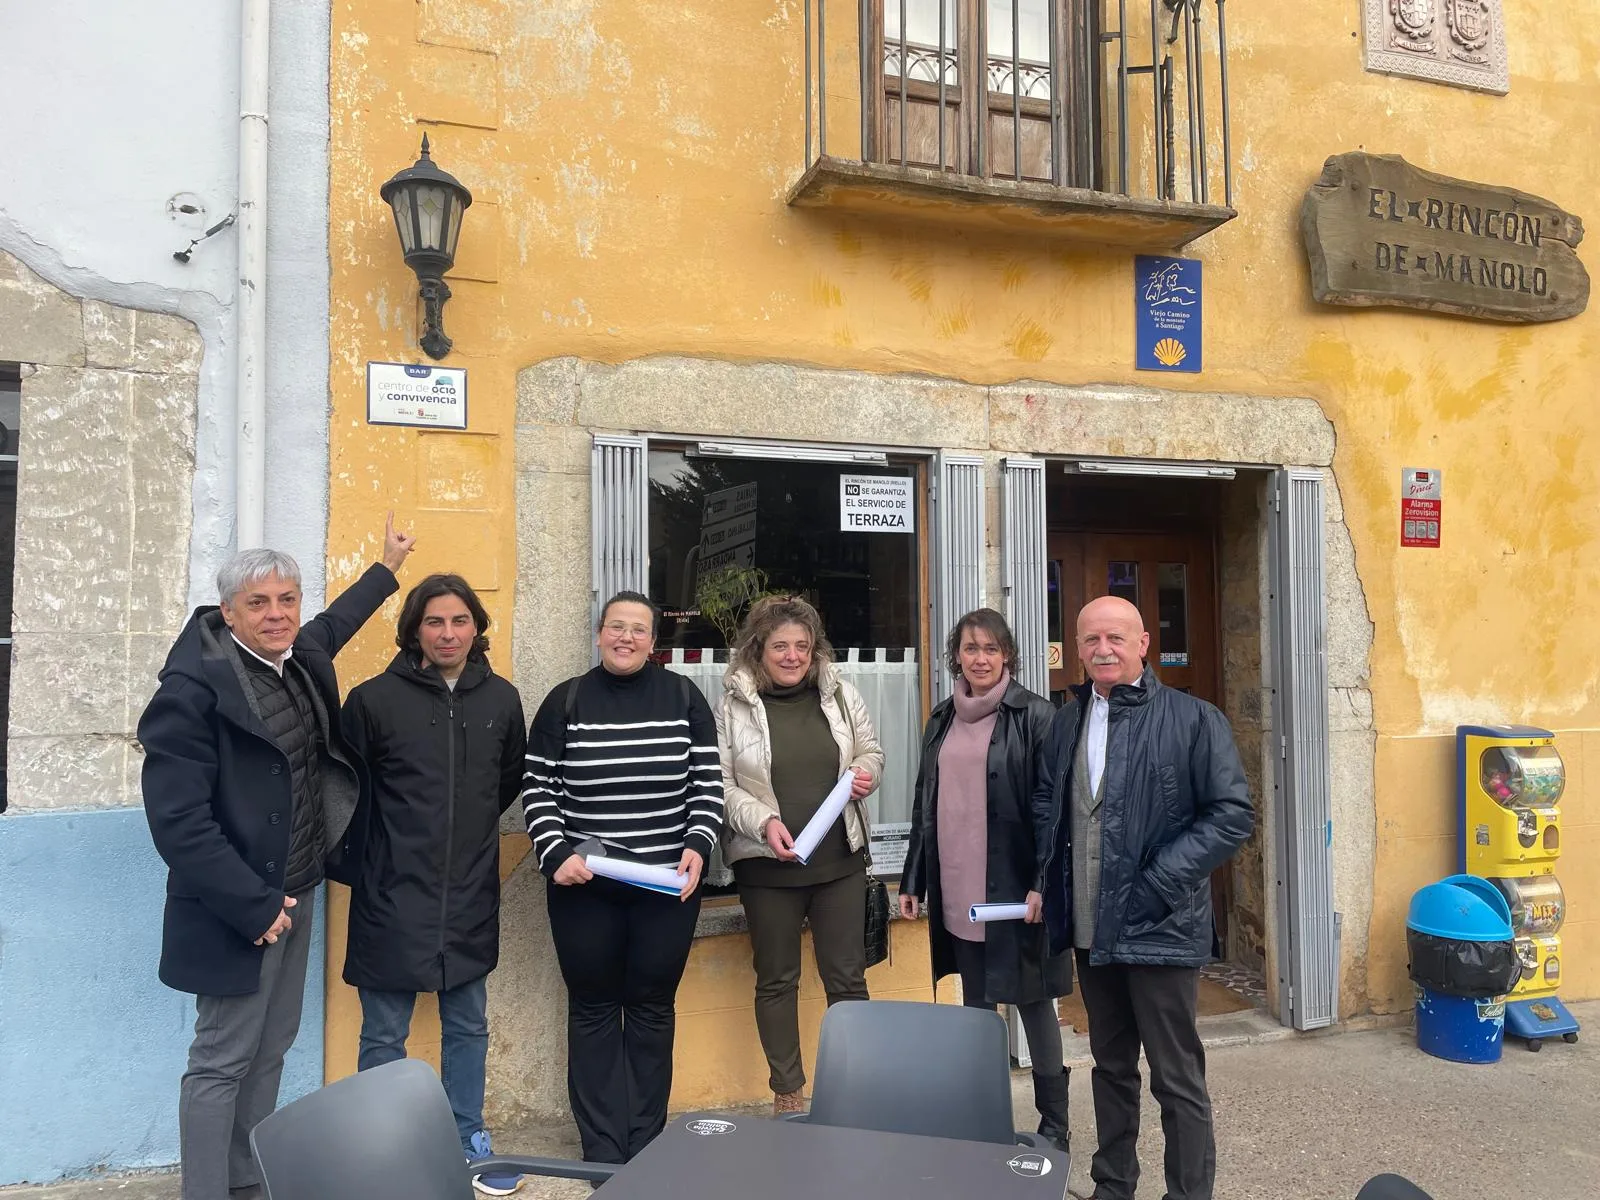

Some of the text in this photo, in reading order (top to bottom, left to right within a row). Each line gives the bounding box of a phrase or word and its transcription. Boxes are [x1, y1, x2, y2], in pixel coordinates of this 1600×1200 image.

[1368, 188, 1404, 223] EL
[1375, 241, 1547, 297] DE MANOLO
[1160, 322, 1184, 330] Santiago
[378, 382, 456, 395] centro de ocio
[378, 392, 457, 404] y convivencia
[847, 485, 859, 495] NO
[871, 488, 906, 496] GARANTIZA
[845, 499, 906, 509] EL SERVICIO DE
[1410, 500, 1433, 508] Alarma
[847, 513, 905, 527] TERRAZA
